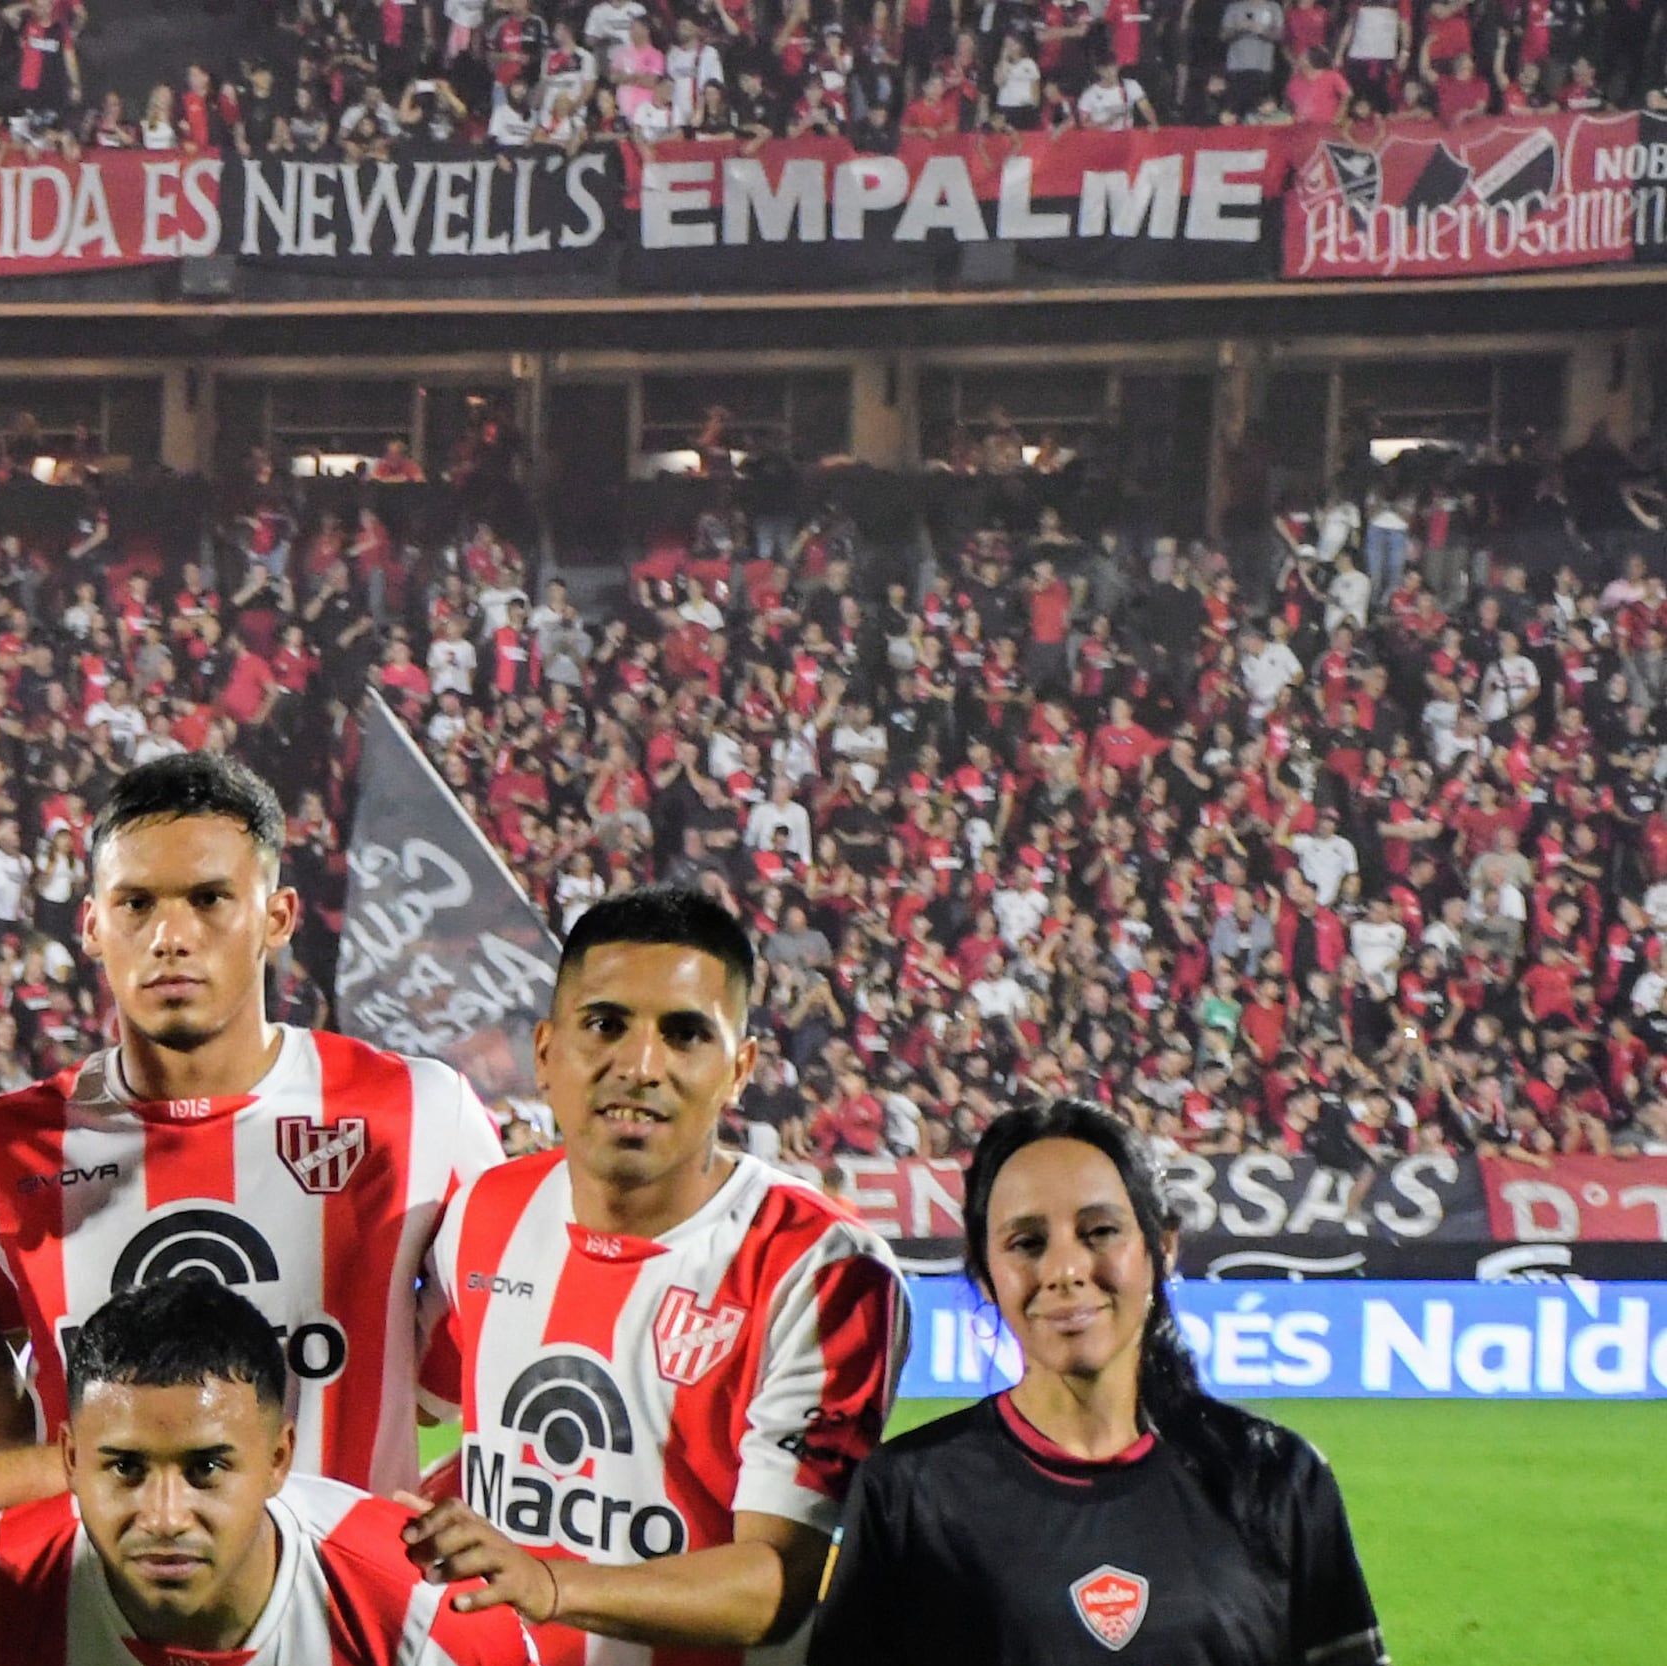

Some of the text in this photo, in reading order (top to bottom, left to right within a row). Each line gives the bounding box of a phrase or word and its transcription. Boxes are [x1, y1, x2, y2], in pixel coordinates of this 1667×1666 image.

[140, 158, 224, 258] ES
[240, 152, 608, 258] NEWELL'S
[639, 148, 1269, 250] EMPALME
[167, 1098, 212, 1120] 1918
[1360, 1296, 1667, 1394] Nald
[466, 1445, 685, 1560] Macro
